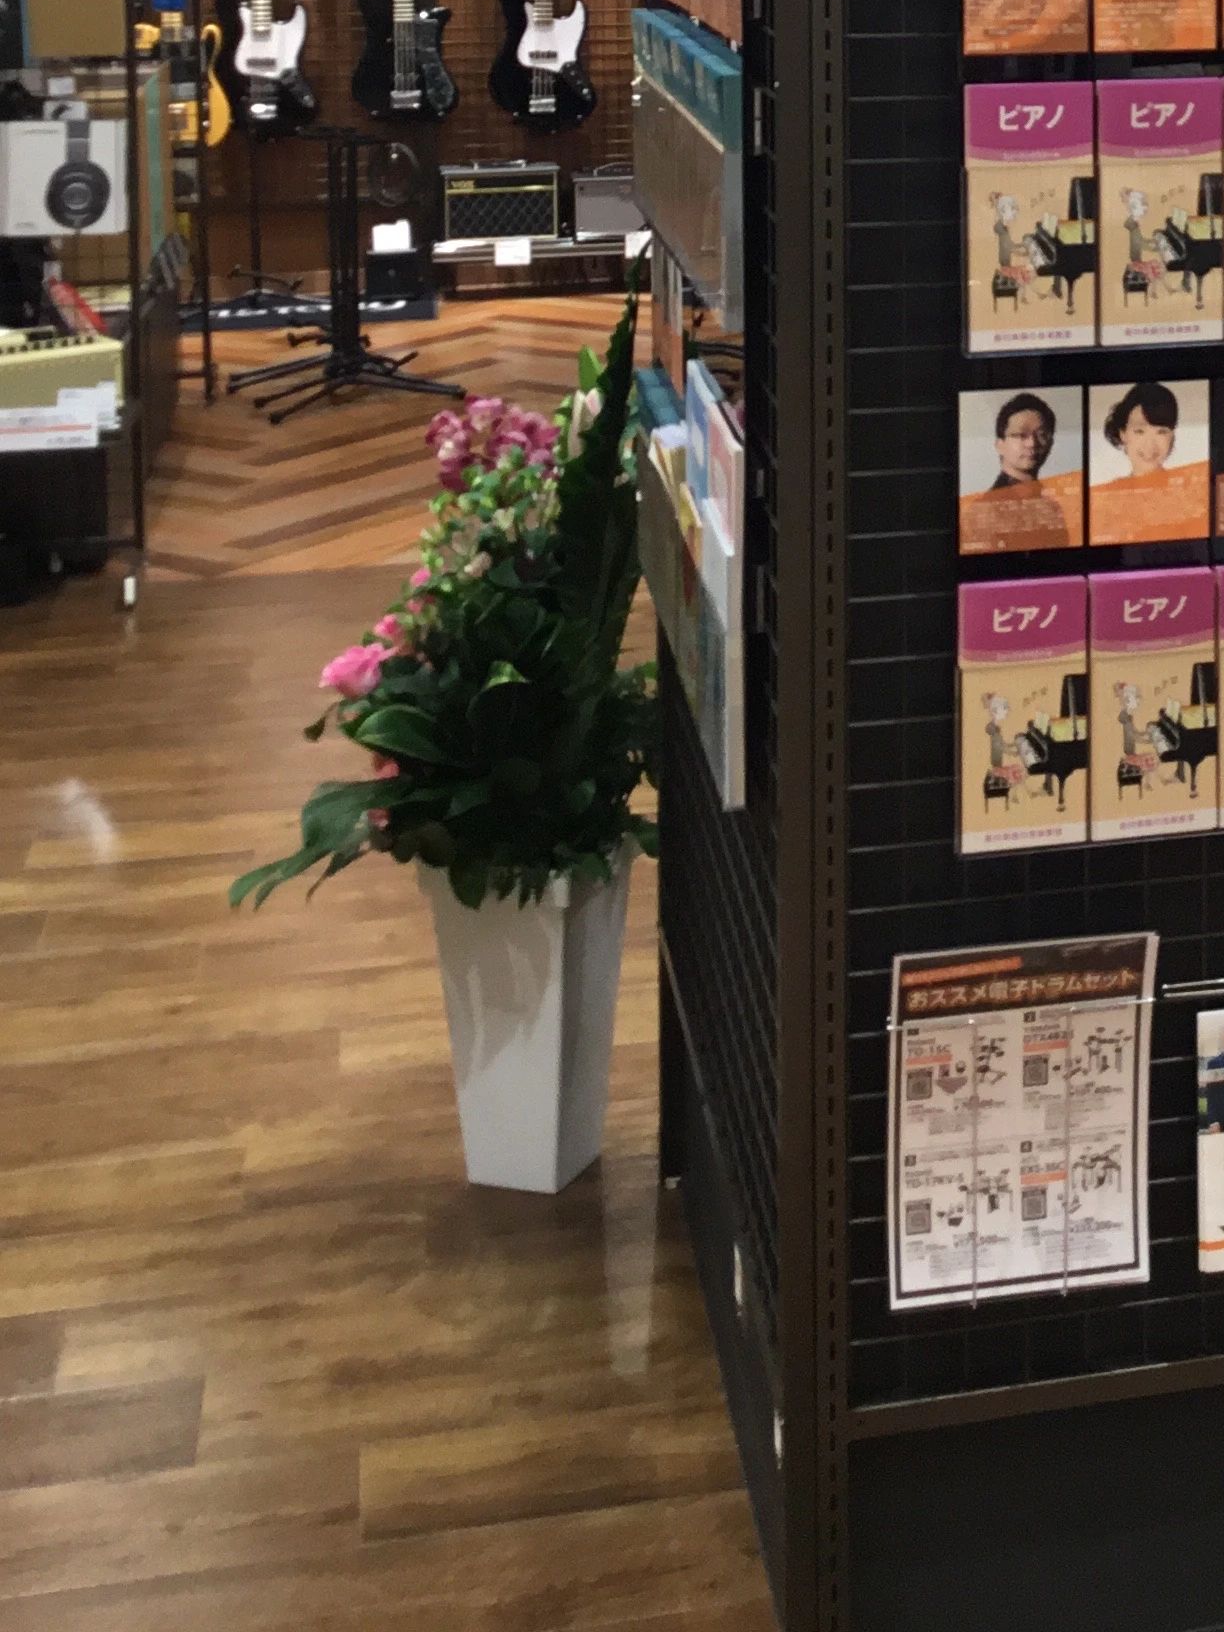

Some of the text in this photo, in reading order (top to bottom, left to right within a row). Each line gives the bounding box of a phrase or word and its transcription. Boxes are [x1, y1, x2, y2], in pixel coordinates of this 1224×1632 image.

[1000, 104, 1065, 131] ピアノ
[1131, 102, 1195, 129] ピアノ
[993, 604, 1058, 633] ピアノ
[1123, 595, 1187, 624] ピアノ
